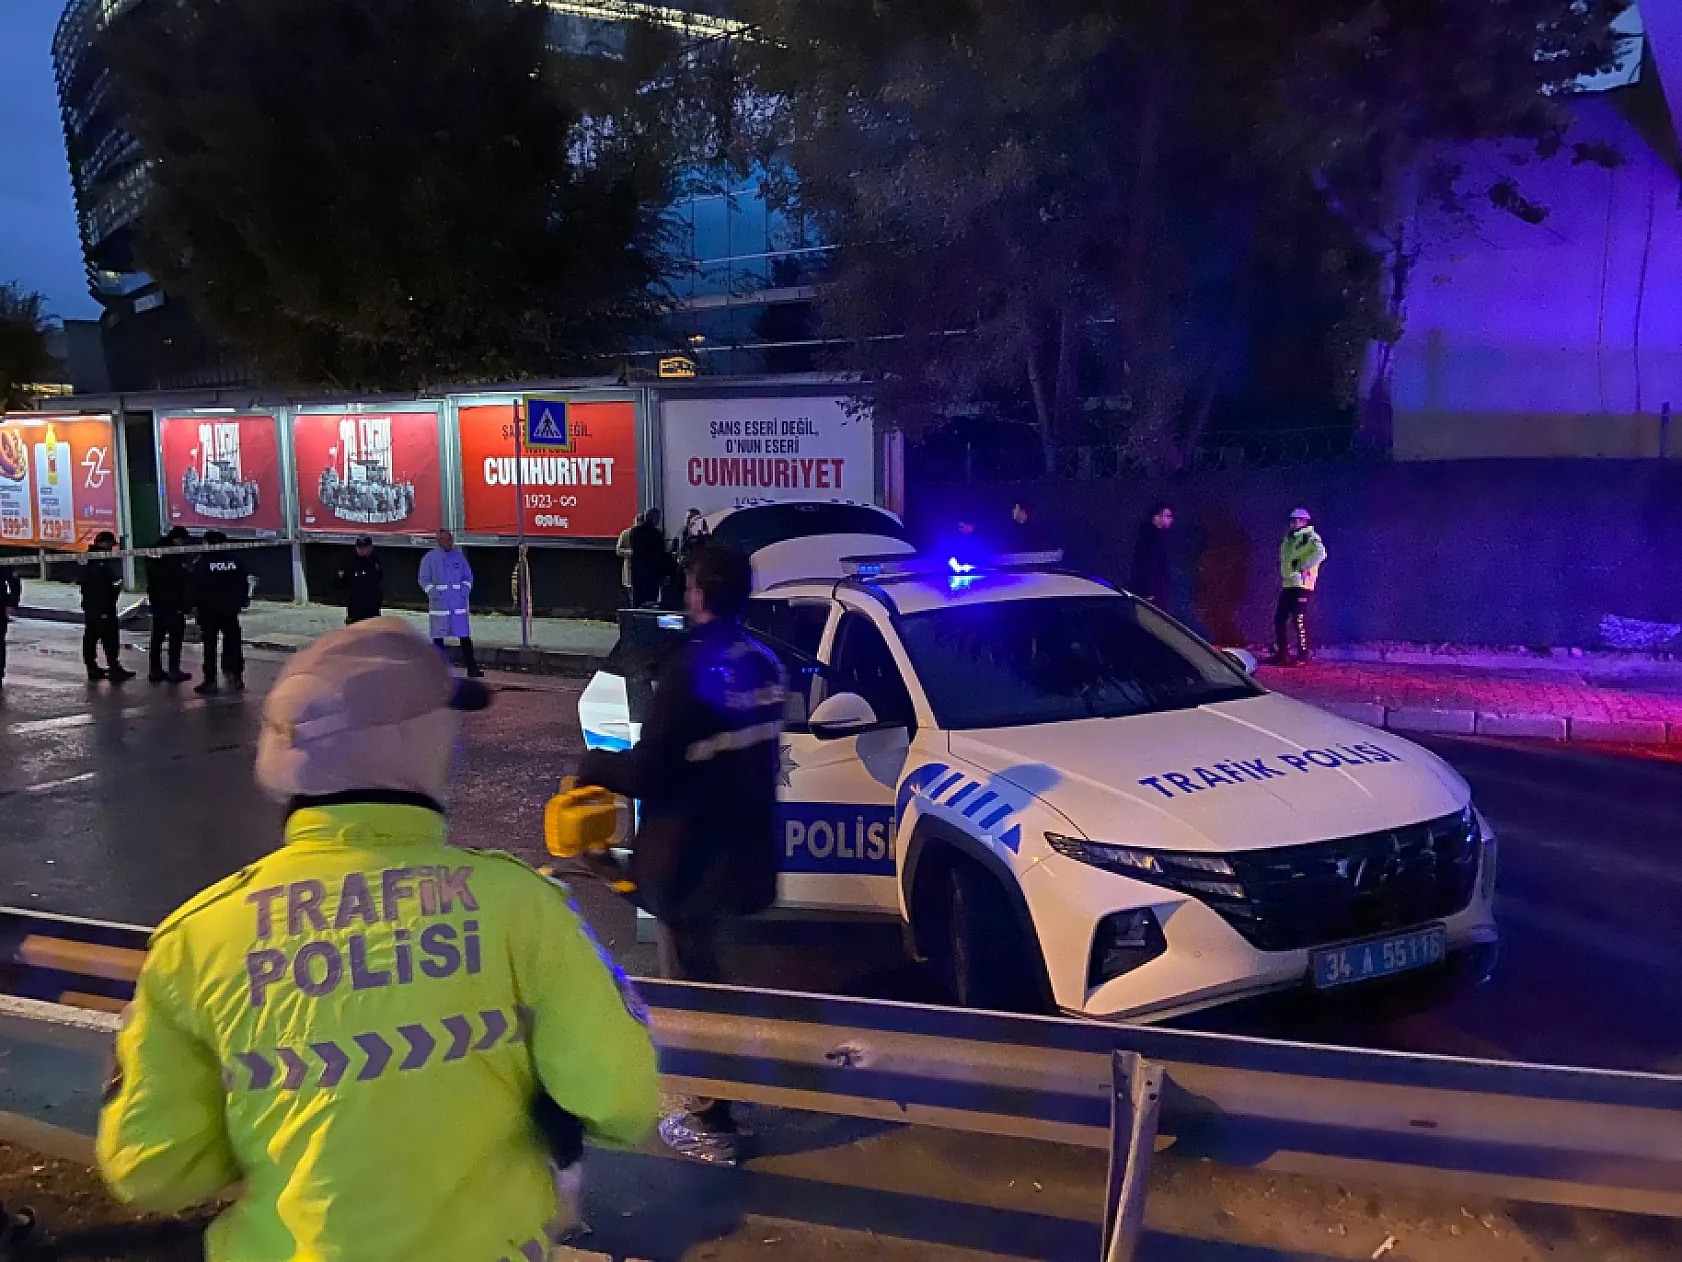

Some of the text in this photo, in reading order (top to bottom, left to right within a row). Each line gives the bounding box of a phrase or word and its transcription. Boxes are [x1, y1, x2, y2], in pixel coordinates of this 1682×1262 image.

[710, 420, 741, 438] ŞANS
[745, 418, 778, 436] ESERİ
[765, 437, 800, 454] ESERİ
[483, 457, 615, 485] CUMHURİYET
[687, 456, 845, 489] CUMHURİYET
[1138, 741, 1402, 798] TRAFİK POLİSİ
[246, 864, 480, 940] TRAFİK
[247, 919, 482, 1008] POLİSİ
[1326, 950, 1351, 981] 34
[1362, 946, 1374, 974] A
